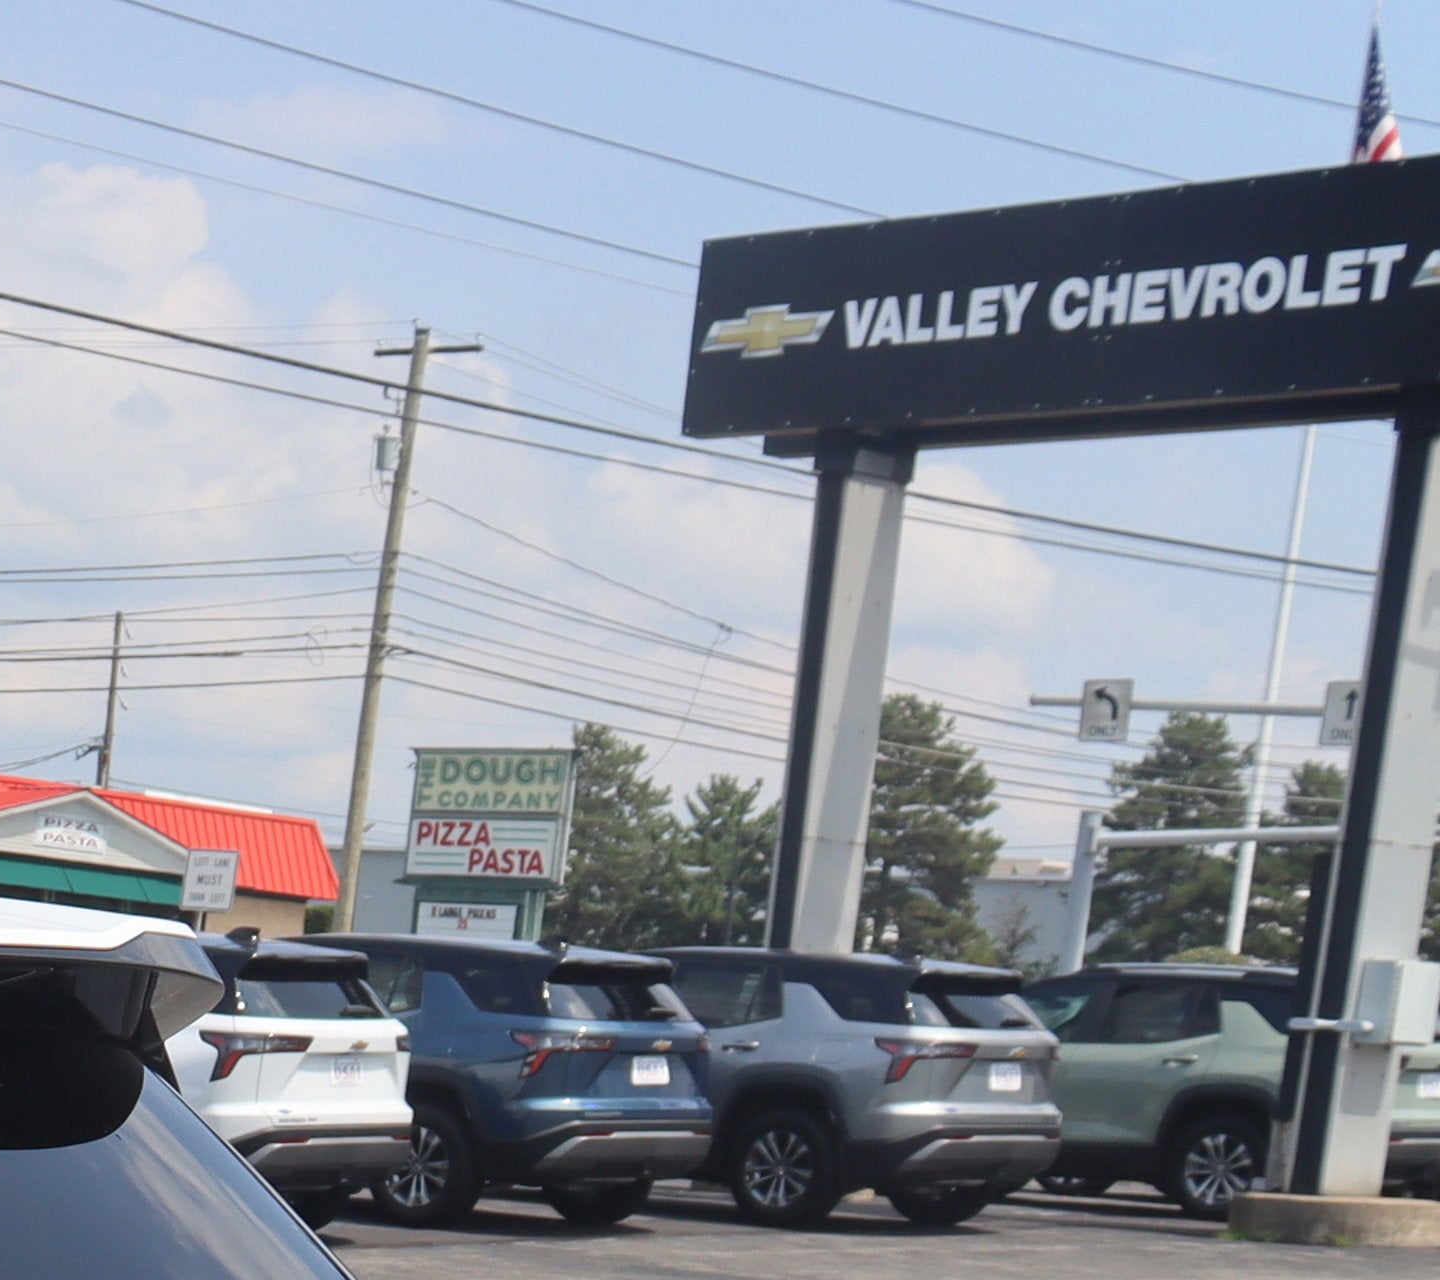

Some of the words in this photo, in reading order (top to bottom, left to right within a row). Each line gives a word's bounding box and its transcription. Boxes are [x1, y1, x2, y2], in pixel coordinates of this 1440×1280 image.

[843, 281, 1038, 349] VALLEY
[1049, 243, 1407, 332] CHEVROLET
[418, 758, 437, 805] THE
[440, 756, 565, 786] DOUGH
[437, 790, 560, 809] COMPANY
[44, 817, 98, 833] PIZZA
[417, 821, 491, 846] PIZZA
[43, 832, 97, 848] PASTA
[468, 848, 544, 875] PASTA
[197, 873, 223, 887] MUST
